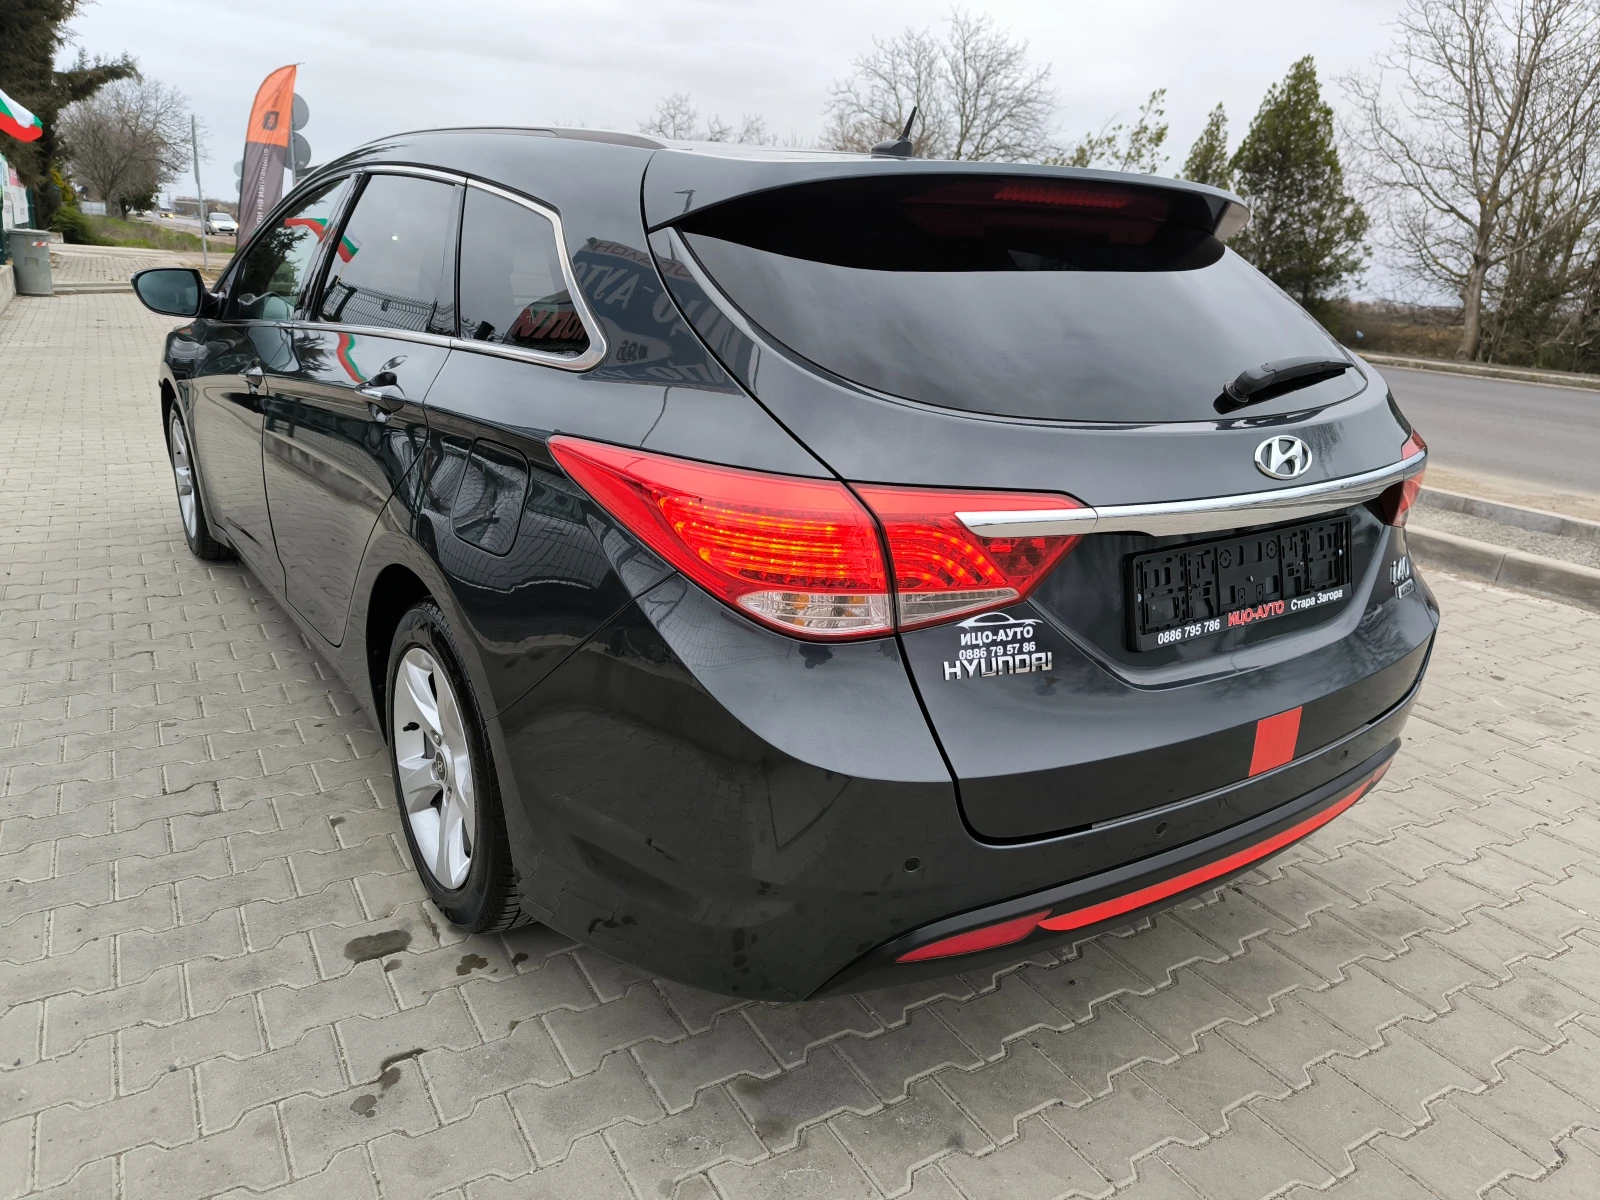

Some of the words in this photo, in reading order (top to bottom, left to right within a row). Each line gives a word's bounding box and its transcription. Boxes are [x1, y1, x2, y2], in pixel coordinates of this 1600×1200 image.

[1157, 629, 1182, 645] 0886
[1184, 624, 1202, 638] 795
[1203, 619, 1220, 634] 786
[1227, 600, 1285, 627] ИЦО-АУТО
[1290, 595, 1316, 611] Стара
[1316, 588, 1343, 606] Загора
[960, 626, 1034, 647] ИЦО-АУТО
[958, 647, 987, 661] 0886
[989, 645, 1004, 658] 79
[1006, 643, 1020, 655] 57
[1022, 641, 1036, 653] 86
[943, 651, 1053, 681] HYUNDAI
